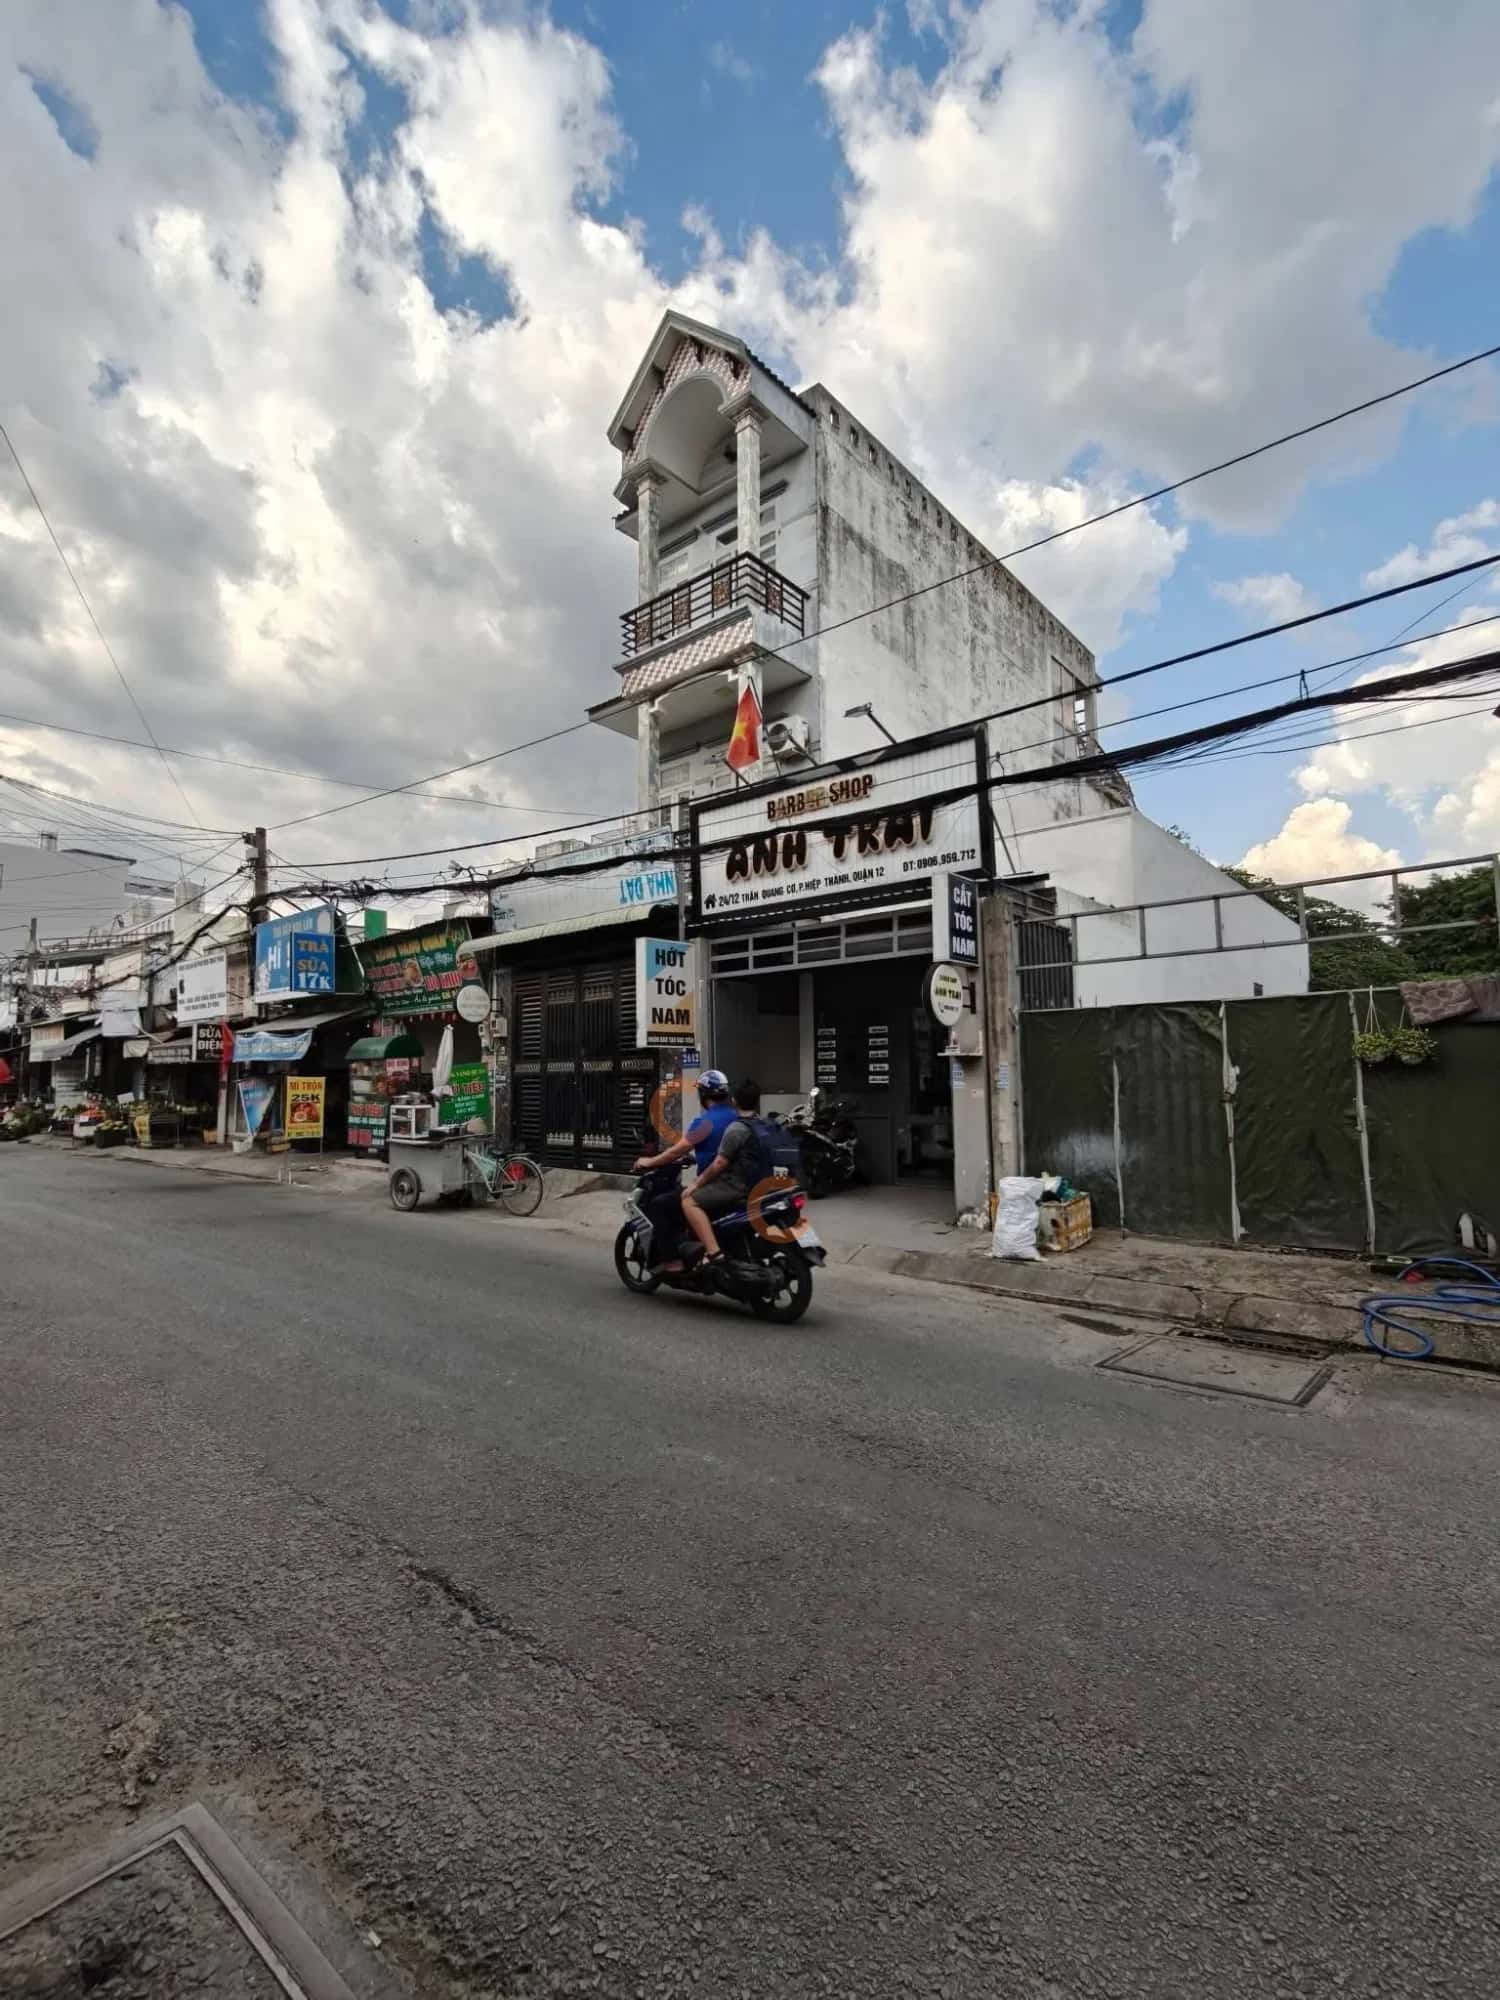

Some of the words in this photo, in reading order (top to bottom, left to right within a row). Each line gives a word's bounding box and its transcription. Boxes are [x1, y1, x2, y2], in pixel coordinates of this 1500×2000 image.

[829, 774, 873, 804] SHOP
[725, 831, 808, 883] ANH
[875, 866, 885, 878] 12
[953, 910, 974, 932] TÓC
[655, 946, 686, 968] HỚT
[952, 937, 976, 957] NAM
[655, 975, 686, 996] TÓC
[651, 1007, 690, 1025] NAM
